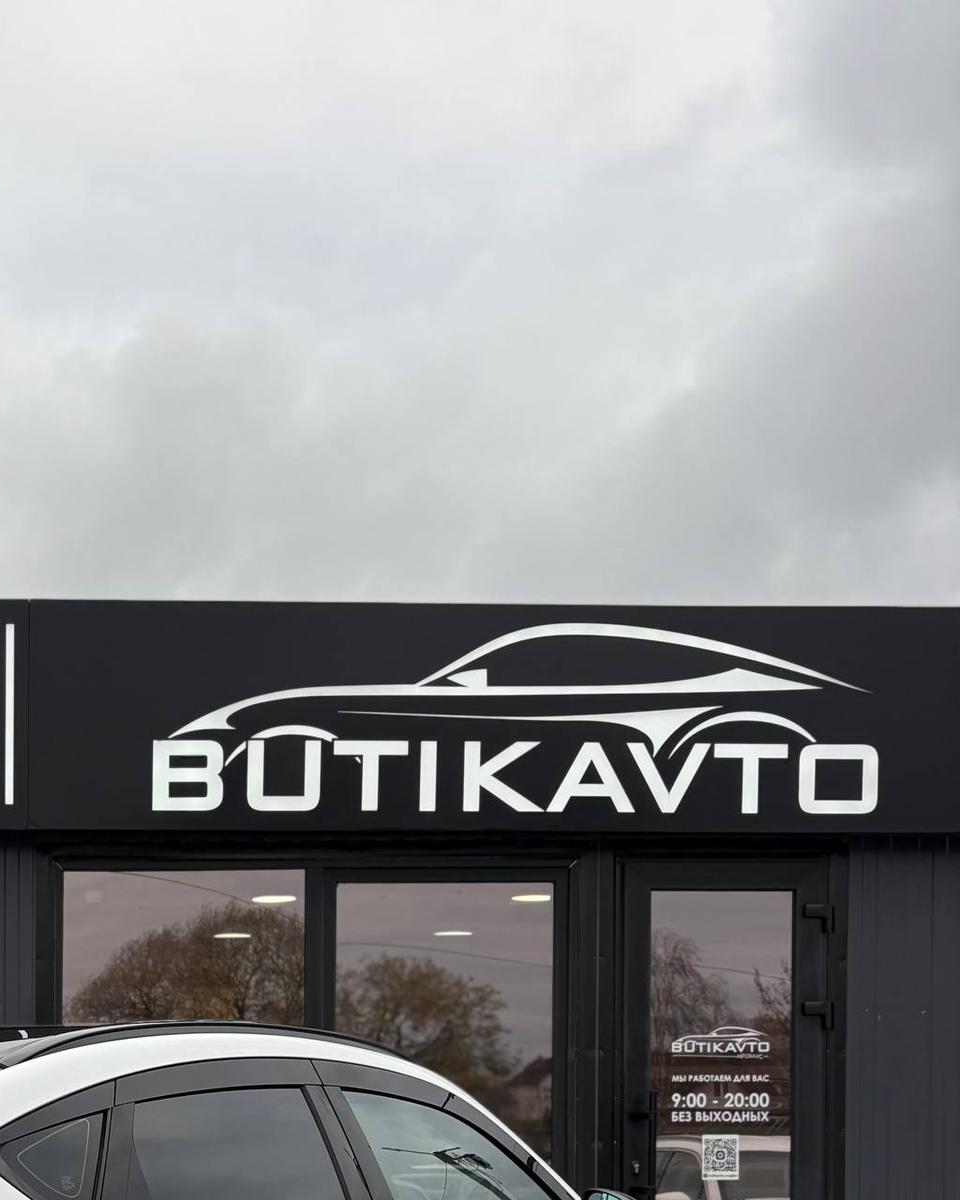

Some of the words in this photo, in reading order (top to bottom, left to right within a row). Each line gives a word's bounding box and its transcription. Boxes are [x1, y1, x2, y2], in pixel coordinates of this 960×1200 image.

[151, 738, 879, 815] BUTIKAVTO
[671, 1041, 770, 1053] BUTIKAVTO
[671, 1074, 687, 1083] МЫ
[688, 1074, 732, 1083] РАБОТАЕМ
[732, 1074, 751, 1083] ДЛЯ
[752, 1074, 770, 1083] ВАС
[671, 1092, 707, 1108] 9:00
[724, 1092, 770, 1108] 20:00
[671, 1110, 692, 1122] БЕЗ
[695, 1110, 769, 1123] ВЫХОДНЫХ
